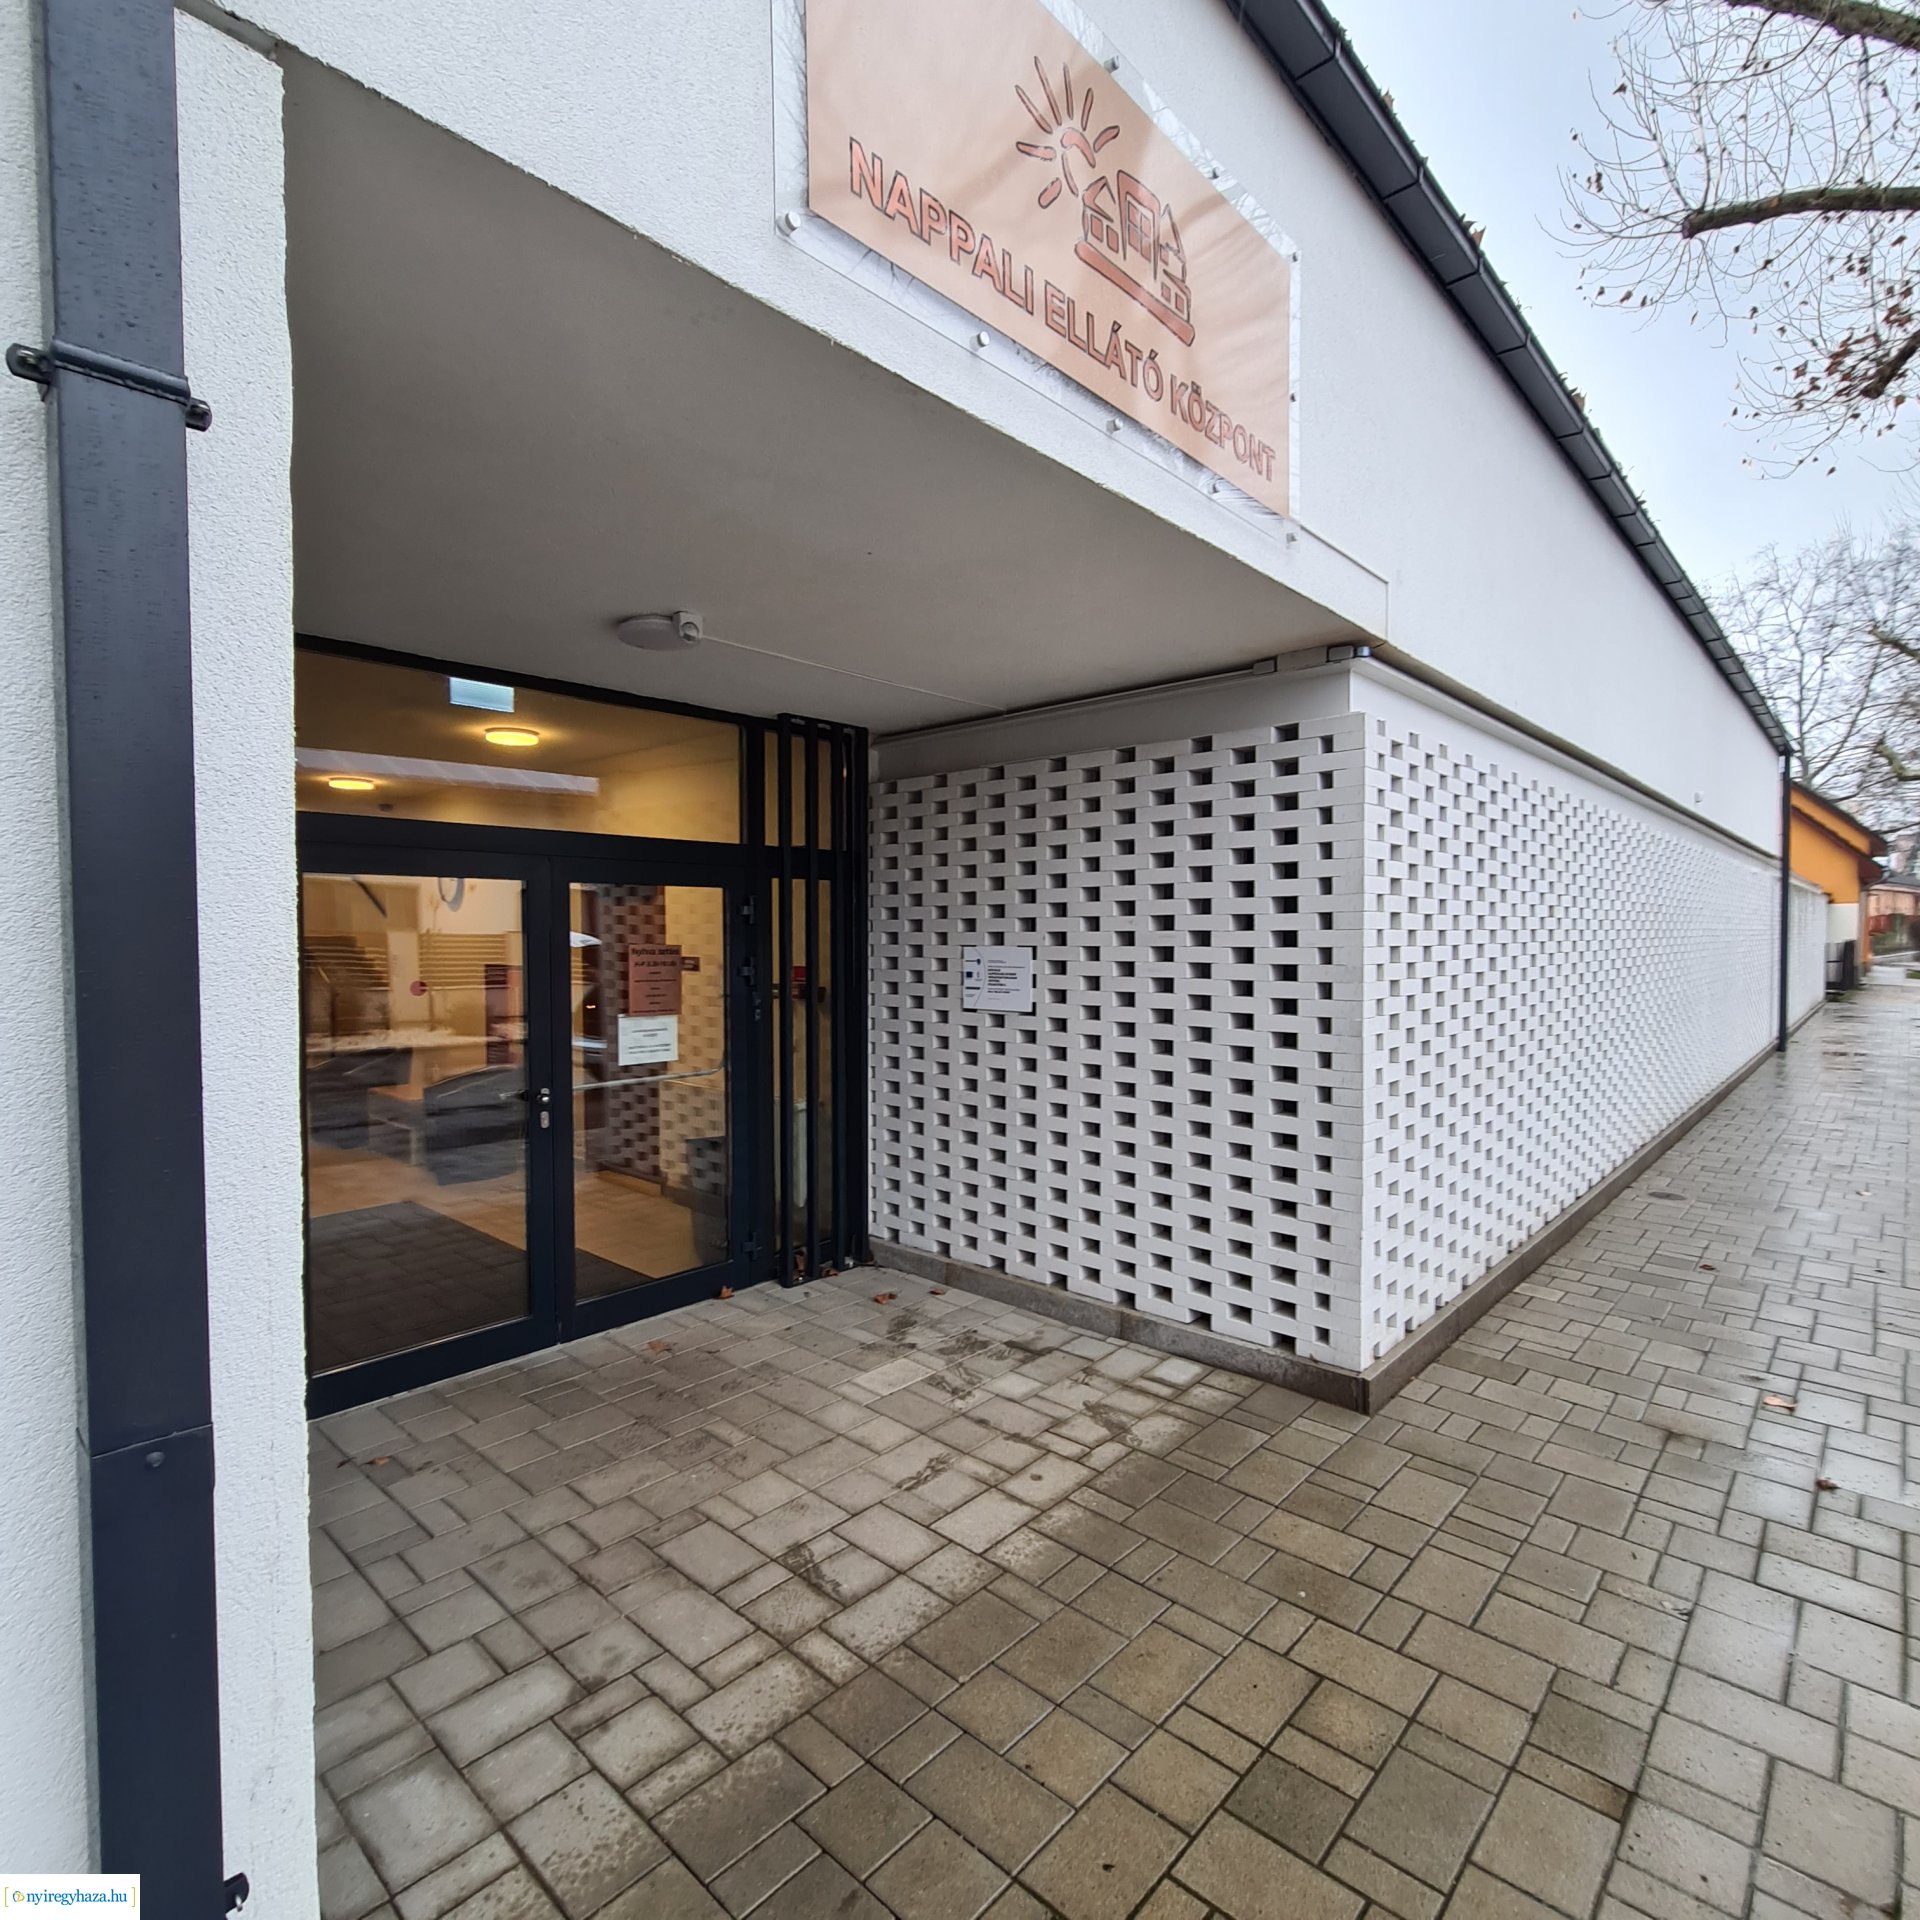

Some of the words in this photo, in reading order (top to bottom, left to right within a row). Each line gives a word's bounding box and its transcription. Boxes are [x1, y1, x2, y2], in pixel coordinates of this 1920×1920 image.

[849, 137, 1035, 316] NAPPALI
[1044, 280, 1163, 403] ELLÁTÓ
[1170, 375, 1276, 483] KÖZPONT
